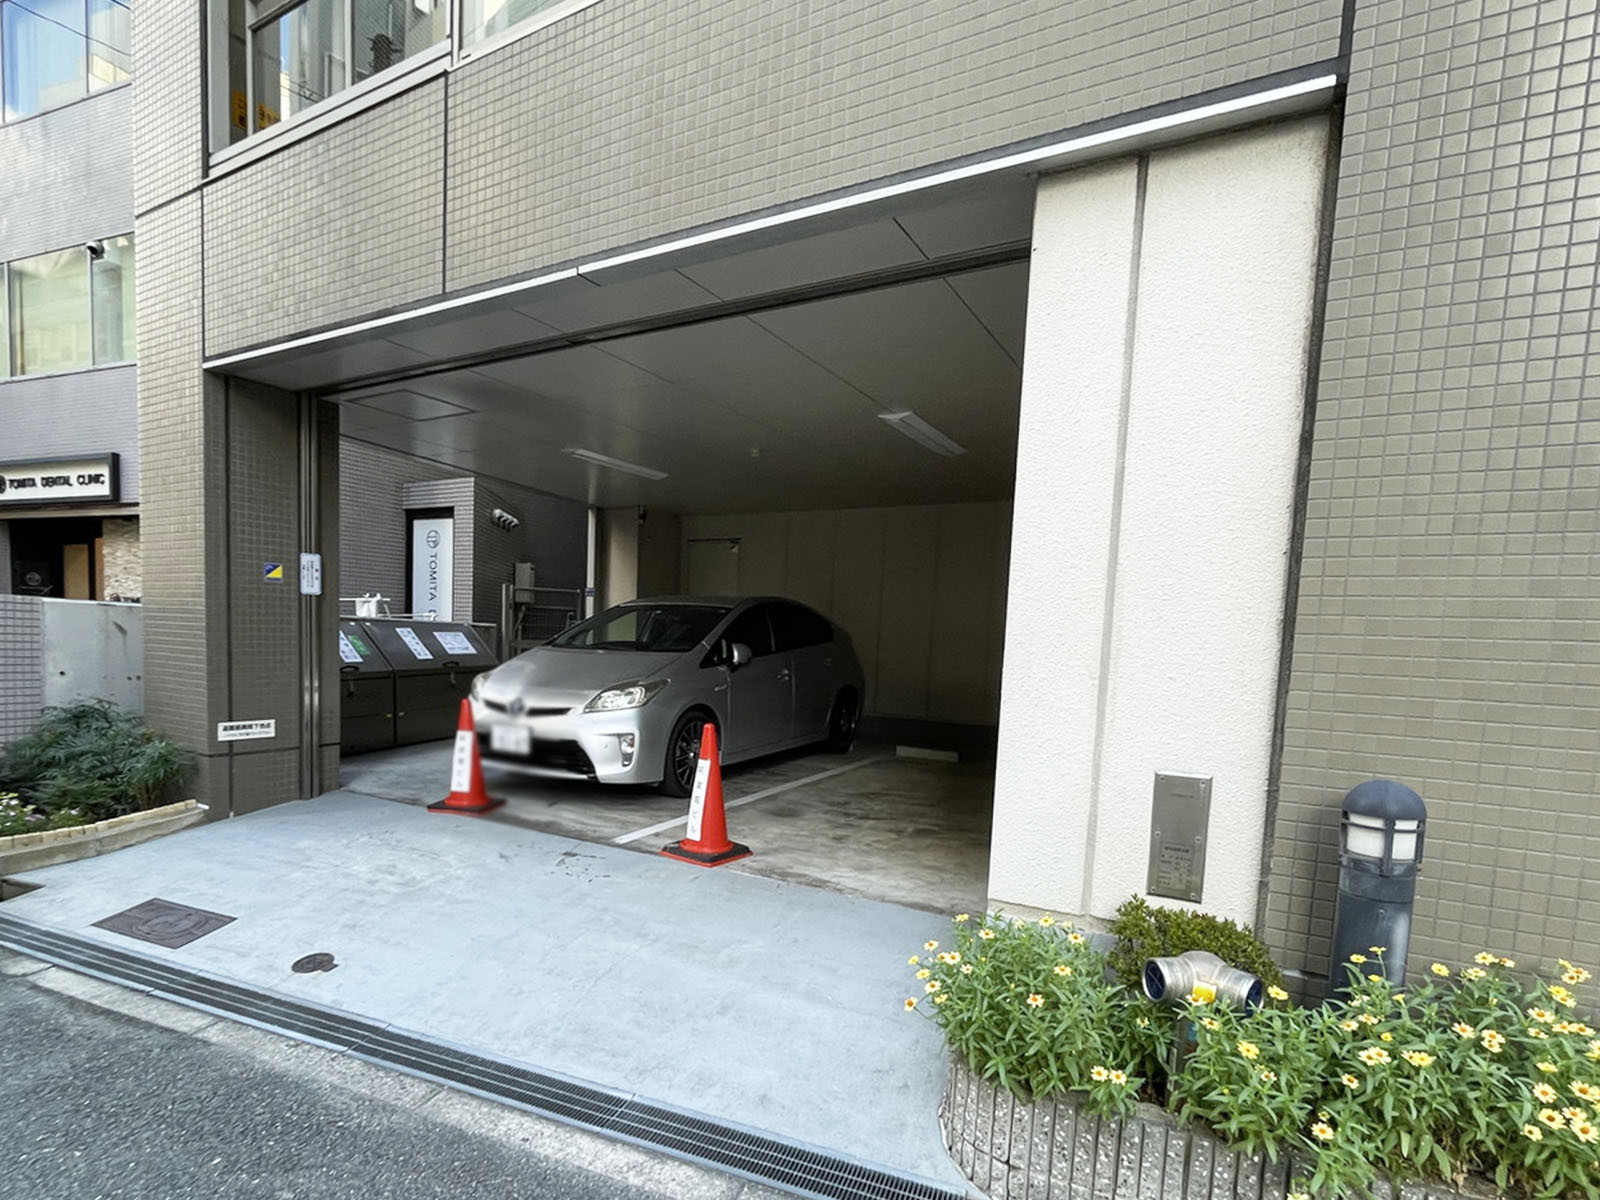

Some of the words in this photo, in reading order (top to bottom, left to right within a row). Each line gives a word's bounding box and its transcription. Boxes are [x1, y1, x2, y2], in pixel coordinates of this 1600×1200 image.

[8, 478, 37, 489] TOMITA
[77, 474, 105, 486] CLINIC
[428, 552, 438, 601] TOMITA
